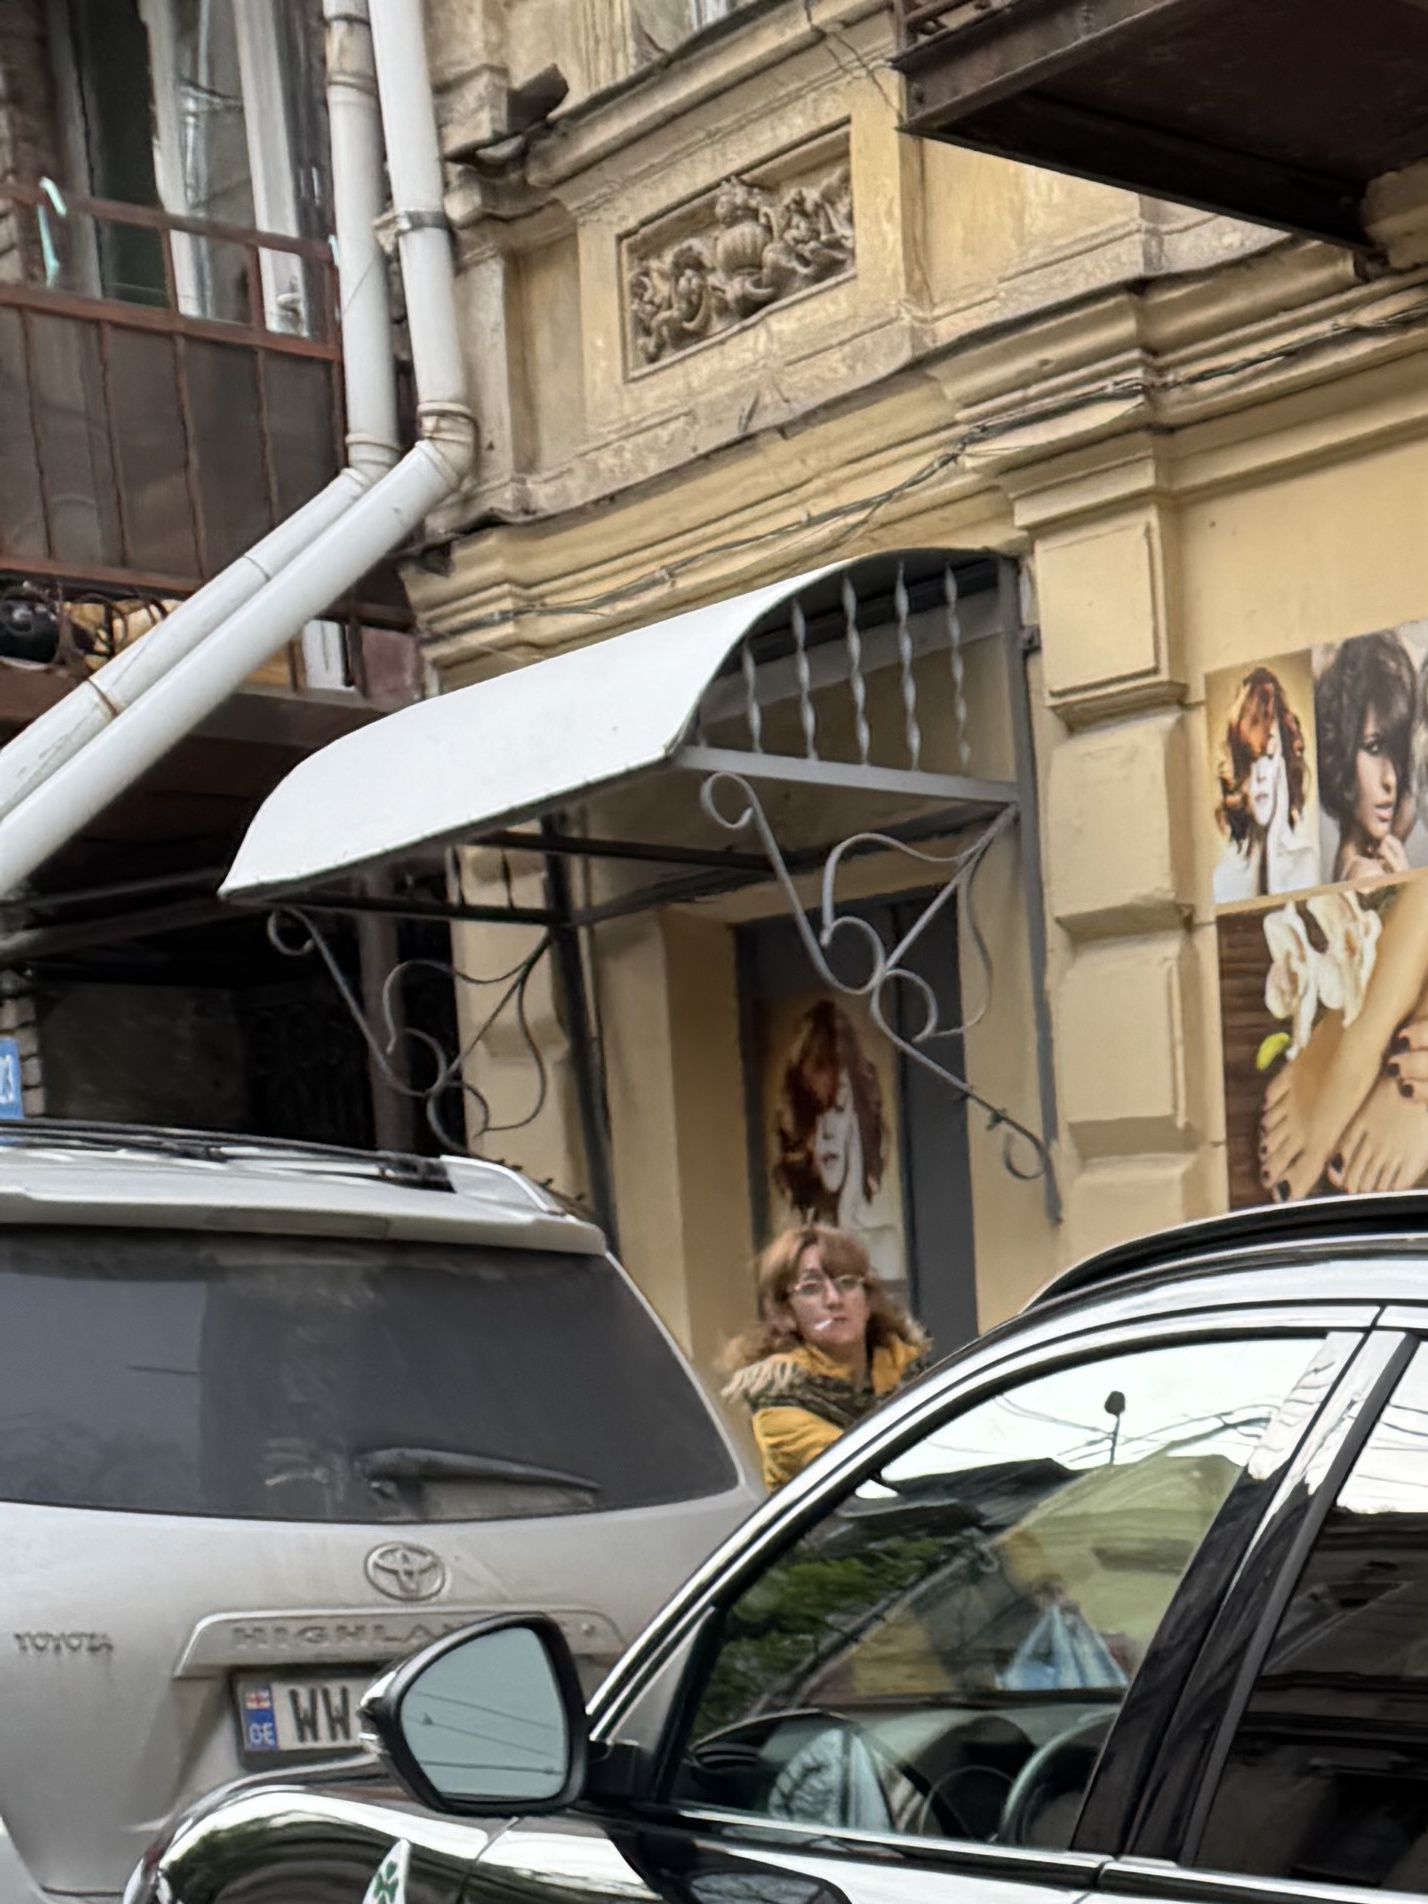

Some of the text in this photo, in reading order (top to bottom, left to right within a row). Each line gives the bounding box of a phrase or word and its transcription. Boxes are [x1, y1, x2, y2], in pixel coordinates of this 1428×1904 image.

[14, 1631, 114, 1653] TOYOTA
[248, 1686, 351, 1746] GE WW
